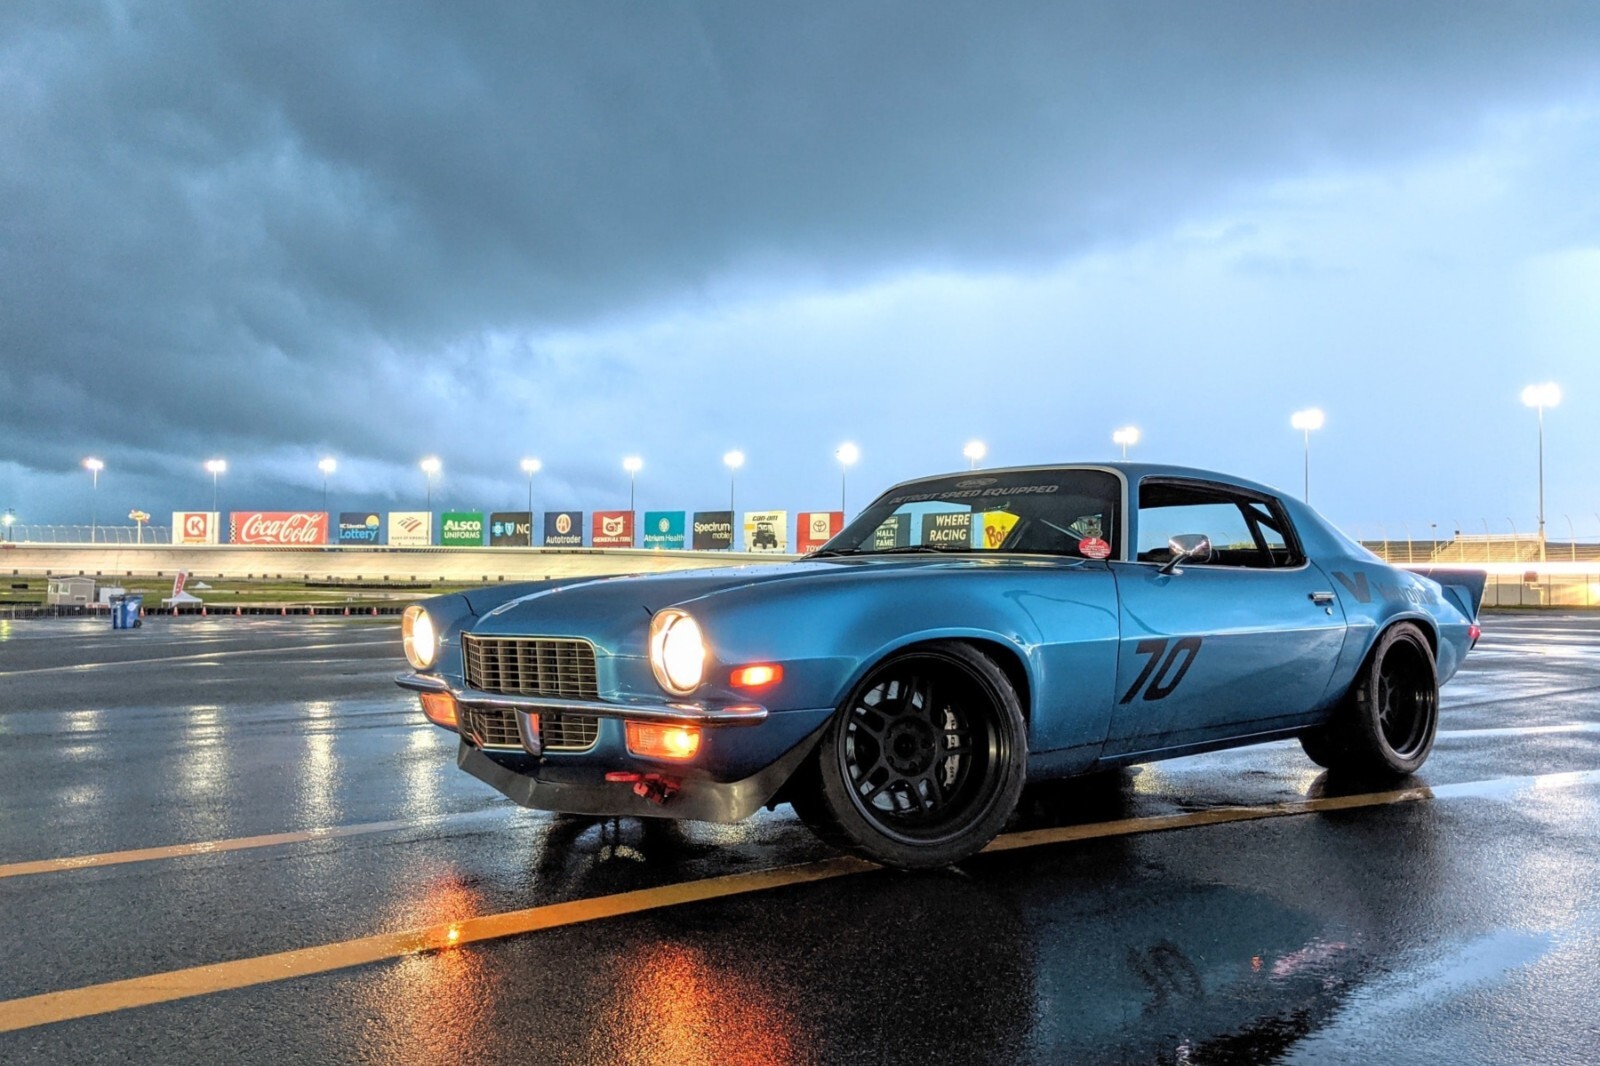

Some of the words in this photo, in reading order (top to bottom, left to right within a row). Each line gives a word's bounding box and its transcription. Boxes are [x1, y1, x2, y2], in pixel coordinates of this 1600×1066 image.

[940, 490, 982, 499] SPEED
[982, 485, 1059, 496] EQUIPPED
[444, 520, 481, 530] ALSCO
[936, 514, 970, 526] WHERE
[191, 520, 204, 533] K
[694, 522, 730, 534] Spectrum
[340, 529, 378, 541] Lottery
[444, 531, 480, 539] UNIFORMS
[546, 535, 581, 544] Autotrader
[930, 529, 967, 541] RACING
[1119, 637, 1202, 704] 70
